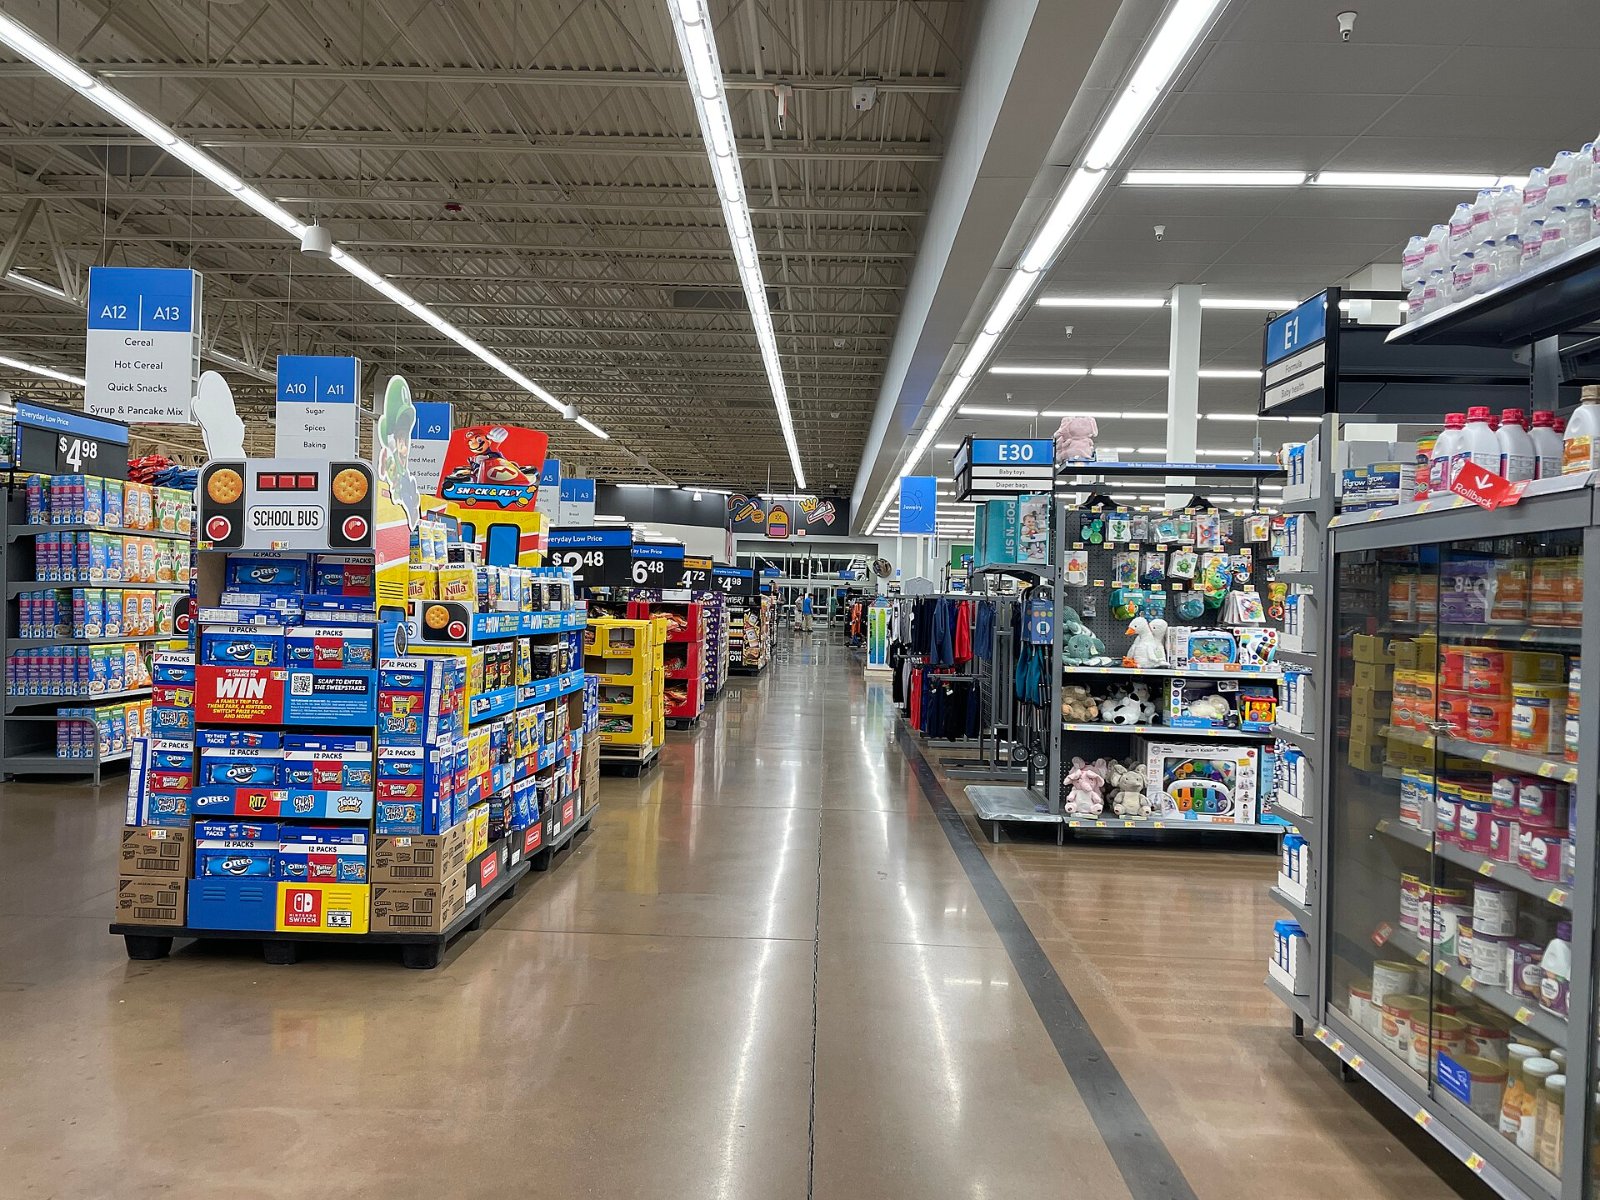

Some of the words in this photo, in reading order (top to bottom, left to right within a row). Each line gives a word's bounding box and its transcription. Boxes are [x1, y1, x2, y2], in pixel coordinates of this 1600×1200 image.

[101, 305, 127, 319] A12
[153, 307, 180, 321] A13
[1284, 315, 1299, 350] E1
[124, 337, 154, 347] Cereal
[114, 360, 130, 370] Hot
[134, 360, 163, 370] Cereal
[107, 382, 132, 394] Quick
[136, 382, 168, 393] Snacks
[285, 383, 307, 394] A10
[327, 384, 345, 395] A11
[1281, 388, 1291, 399] Baby
[90, 405, 113, 417] Syrup
[117, 406, 124, 415] &
[128, 406, 163, 416] Pancake
[166, 407, 183, 416] Mix
[305, 406, 325, 416] Sugar
[21, 409, 45, 422] Everyday
[46, 414, 56, 423] Low
[56, 417, 69, 427] Price
[304, 424, 326, 433] Spices
[427, 425, 441, 434] A9
[303, 441, 327, 450] Baking
[998, 444, 1034, 461] E30
[1454, 483, 1492, 508] Rollback
[902, 504, 923, 512] Jewelry
[1006, 501, 1015, 525] POP
[253, 511, 295, 527] SCHOOL
[298, 511, 319, 526] BUS
[1005, 539, 1015, 556] SIT
[251, 568, 279, 578] OREO
[446, 583, 467, 596] Nilla
[226, 643, 256, 654] OREO
[216, 677, 267, 698] WIN
[226, 766, 257, 778] OREO
[196, 796, 229, 807] OREO
[249, 796, 267, 808] RITZ
[338, 796, 362, 806] Teddy
[222, 858, 253, 869] OREO
